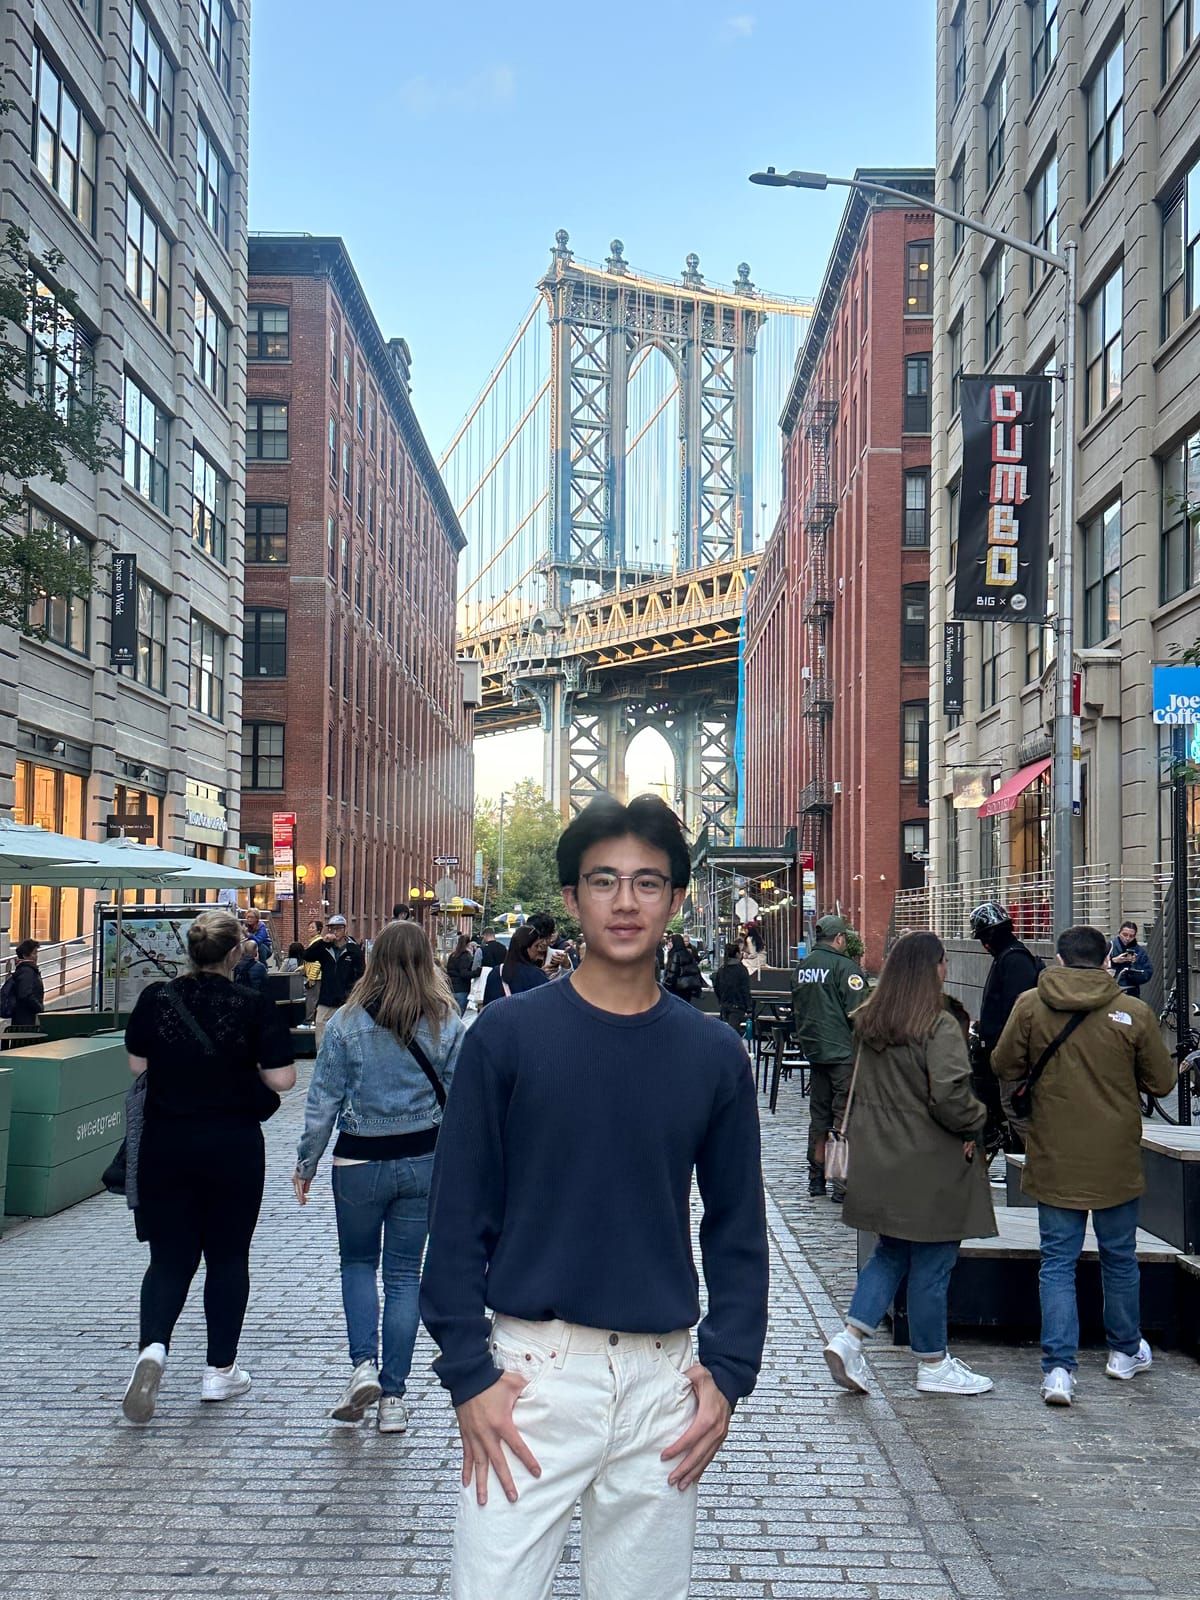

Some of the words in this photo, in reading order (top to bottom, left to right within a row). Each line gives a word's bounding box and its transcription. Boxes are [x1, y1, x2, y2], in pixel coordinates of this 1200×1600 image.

[985, 384, 1029, 587] DUMBO
[114, 559, 125, 581] Space
[115, 583, 122, 592] to
[115, 593, 125, 616] Work
[976, 596, 996, 606] BIG
[944, 635, 954, 676] Washington
[1165, 694, 1200, 712] Joe
[798, 968, 830, 984] DSNY
[76, 1111, 121, 1141] sweetgreen
